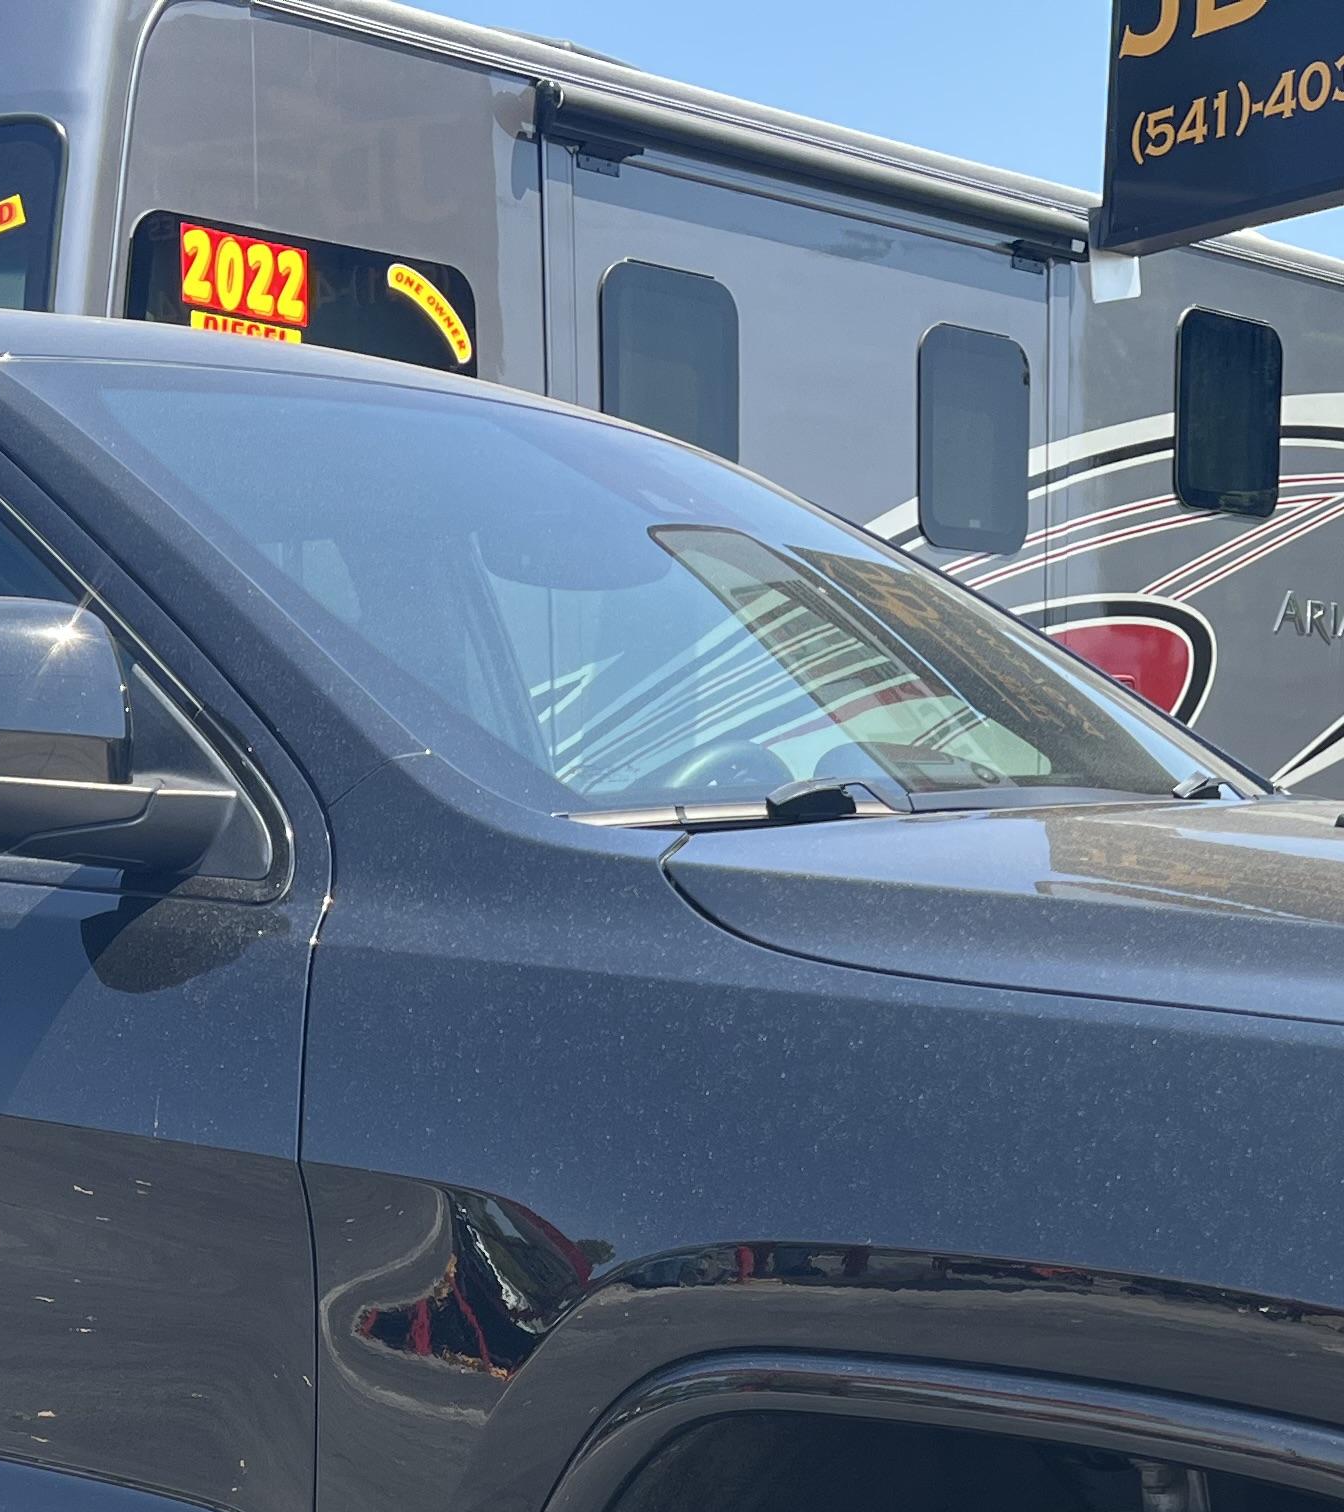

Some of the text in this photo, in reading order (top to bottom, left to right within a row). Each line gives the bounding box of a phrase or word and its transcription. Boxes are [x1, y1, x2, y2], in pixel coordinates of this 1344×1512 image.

[182, 229, 305, 323] 2022
[395, 272, 466, 351] ONE OWNER
